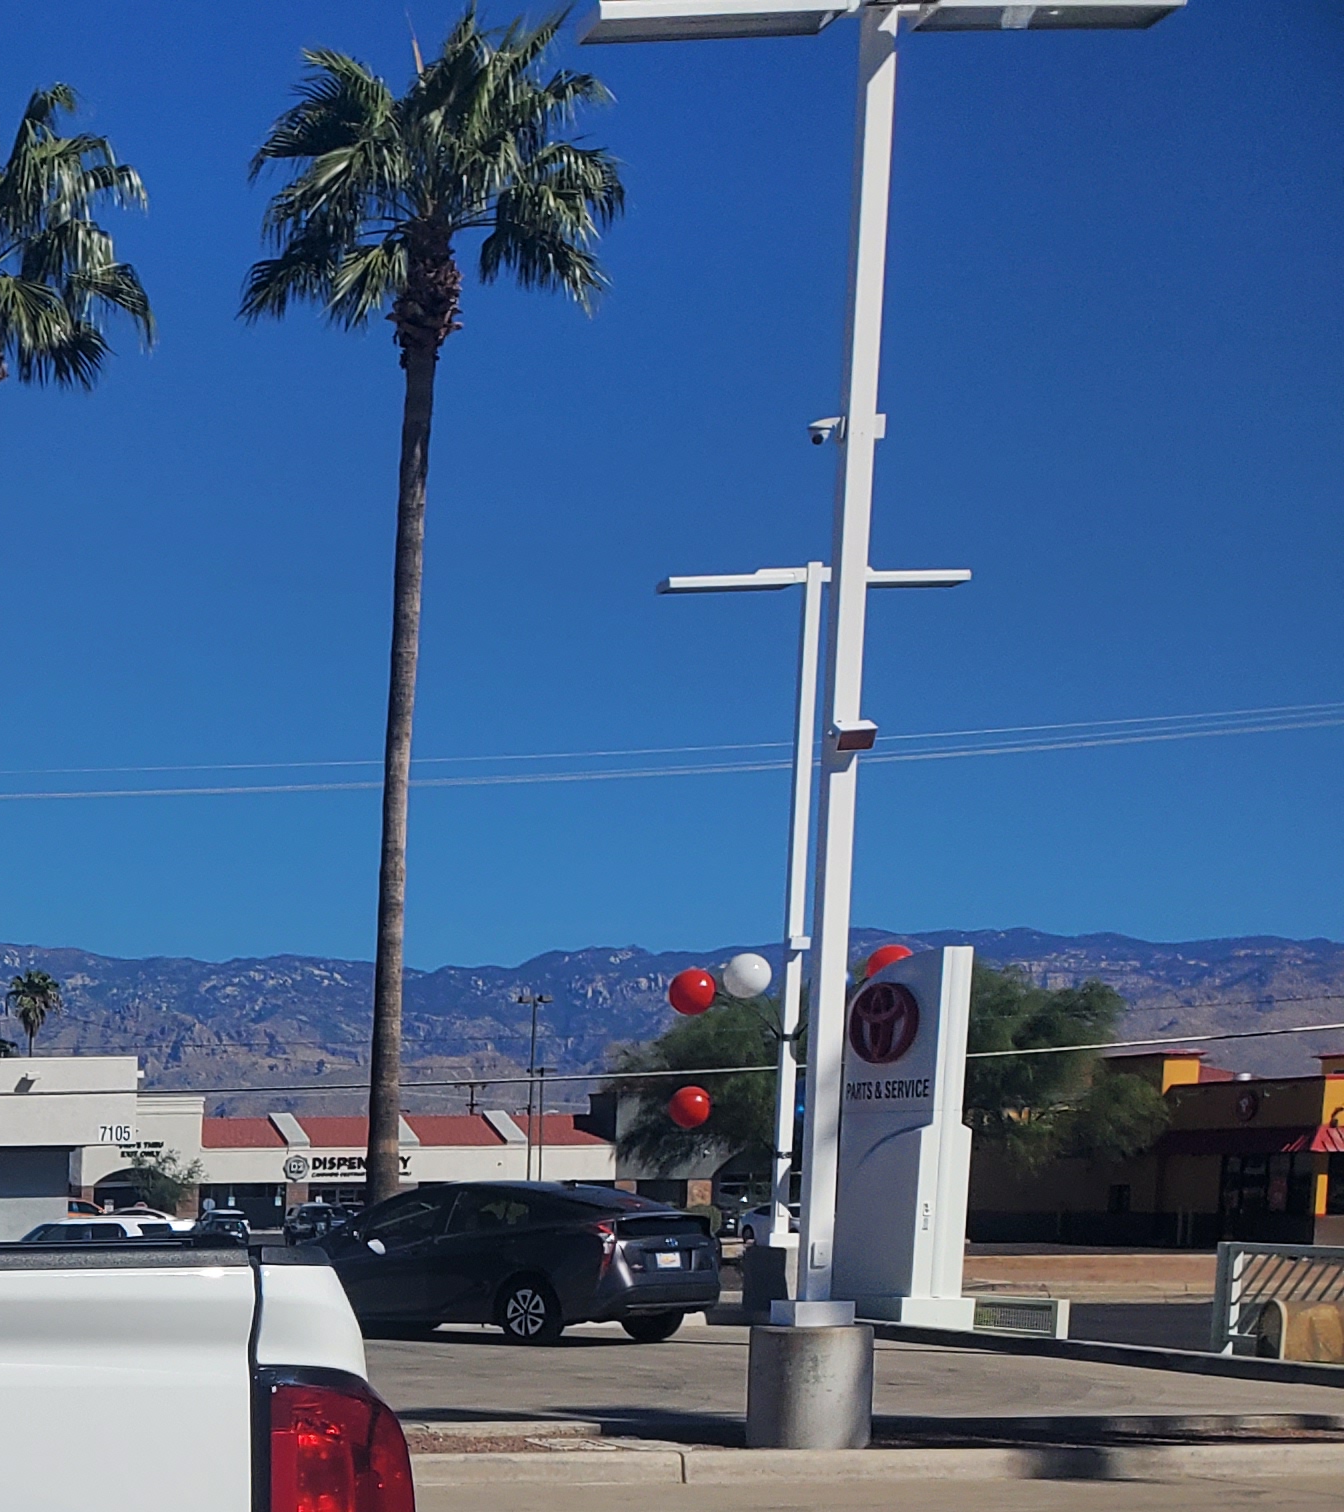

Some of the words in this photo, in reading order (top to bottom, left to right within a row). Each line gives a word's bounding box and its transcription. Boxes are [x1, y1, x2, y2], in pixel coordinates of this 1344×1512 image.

[846, 1082, 872, 1100] PARTS
[875, 1081, 882, 1099] &
[885, 1079, 930, 1099] SERVICE
[100, 1126, 130, 1141] 7105
[140, 1150, 161, 1158] ONLY
[312, 1156, 412, 1170] DISPENY
